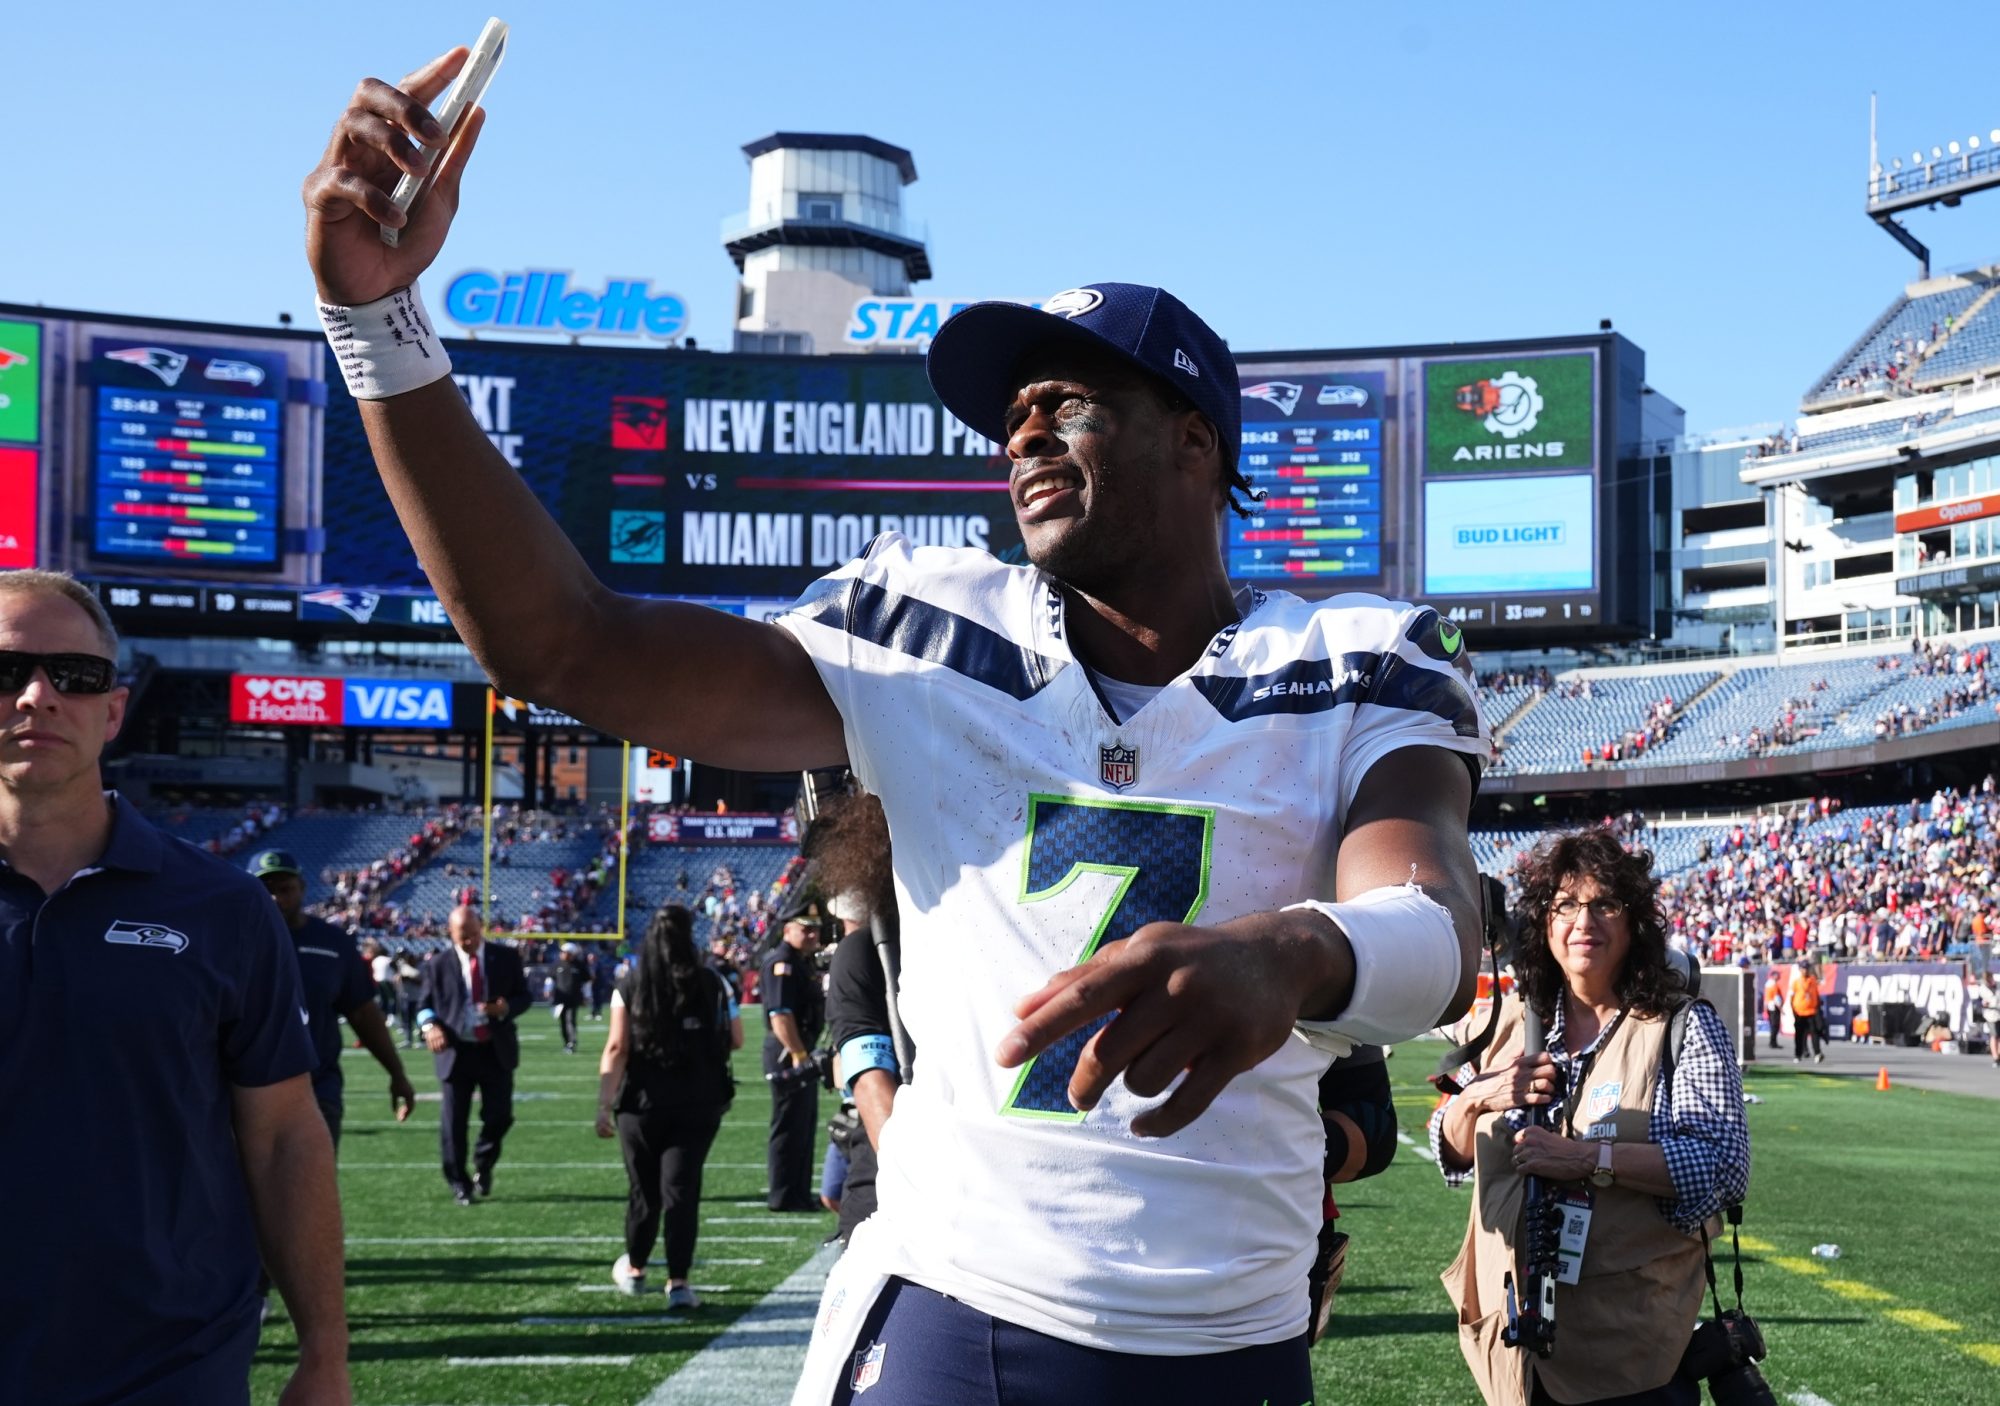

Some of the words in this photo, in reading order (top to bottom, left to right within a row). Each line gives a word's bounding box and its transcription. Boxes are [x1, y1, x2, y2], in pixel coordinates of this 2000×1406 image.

[444, 268, 688, 338] Gillette
[848, 301, 976, 342] STA
[684, 399, 766, 453] NEW
[773, 402, 934, 455] ENGLAND
[942, 405, 1006, 456] PA
[1332, 428, 1370, 441] 29:41
[1340, 452, 1360, 463] 312
[1453, 441, 1565, 461] ARIENS
[1938, 501, 1983, 521] Optum
[683, 511, 802, 566] MIAMI
[1457, 529, 1499, 544] BUD
[1502, 526, 1561, 542] LIGHT
[411, 600, 447, 623] NE
[1449, 607, 1466, 622] 44
[1505, 604, 1522, 620] 33
[1562, 603, 1571, 619] 1
[271, 679, 326, 701] CVS
[1252, 669, 1373, 702] SEAHAWKS
[247, 699, 327, 721] Health
[346, 685, 449, 721] VISA
[1104, 763, 1133, 784] NFL
[998, 793, 1216, 1122] 7
[1591, 1097, 1615, 1115] NFL
[1583, 1122, 1617, 1140] MEDIA
